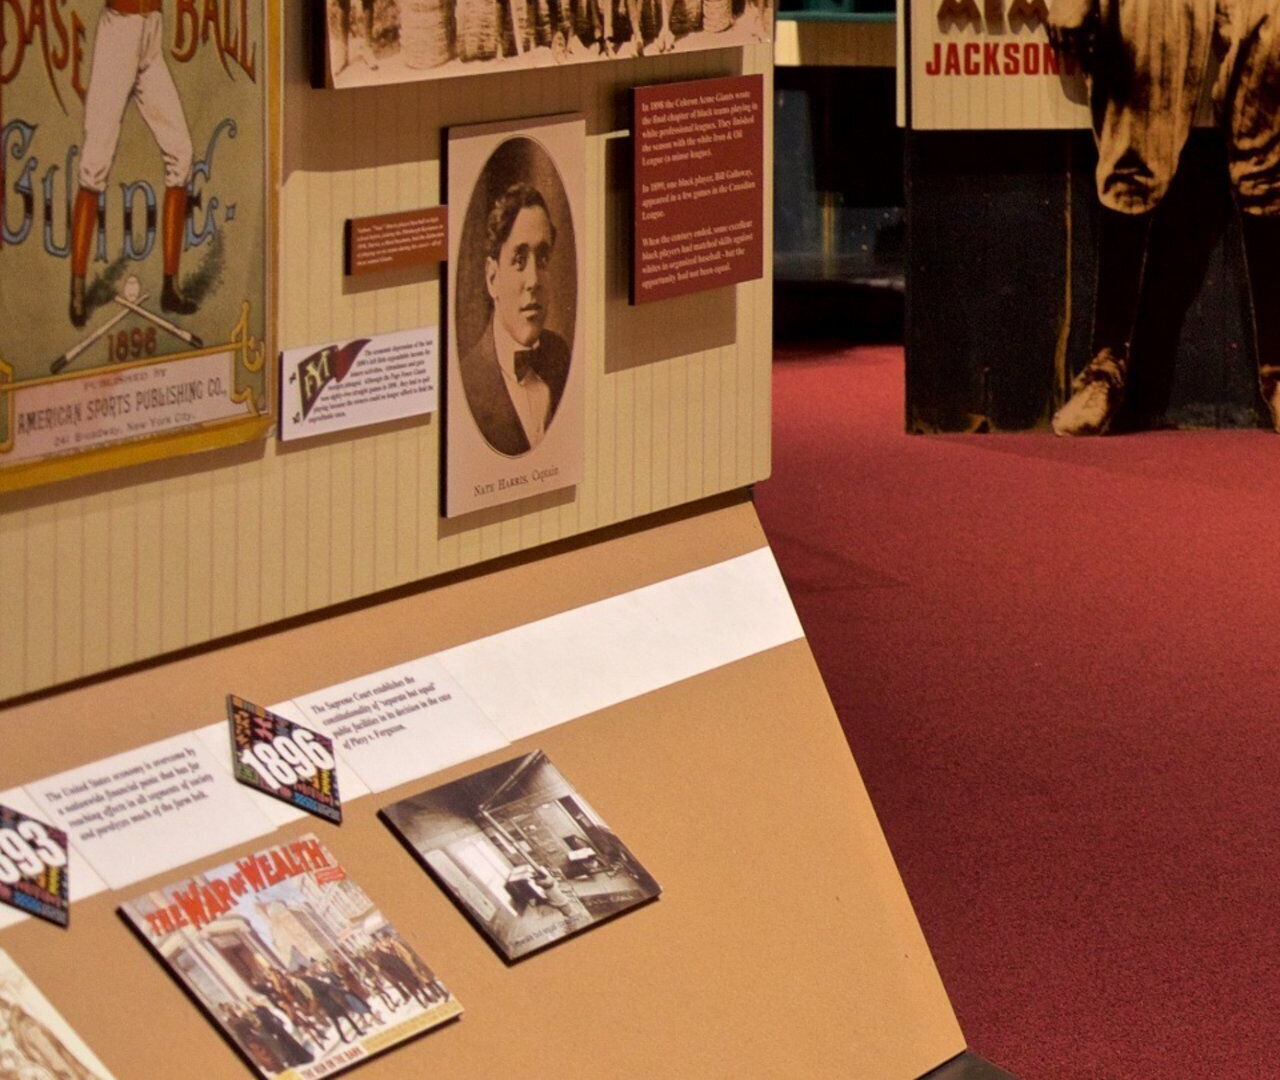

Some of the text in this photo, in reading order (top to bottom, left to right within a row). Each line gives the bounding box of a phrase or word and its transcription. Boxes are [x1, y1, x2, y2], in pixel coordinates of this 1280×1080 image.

[17, 401, 82, 435] AMERICAN
[86, 392, 132, 421] SPORTS
[135, 380, 204, 414] PUBLISHING
[310, 704, 326, 715] The
[325, 696, 353, 711] Supreme
[353, 688, 373, 701] Court
[240, 728, 335, 790] 1896
[145, 838, 332, 937] THE WAR OF WEALTH
